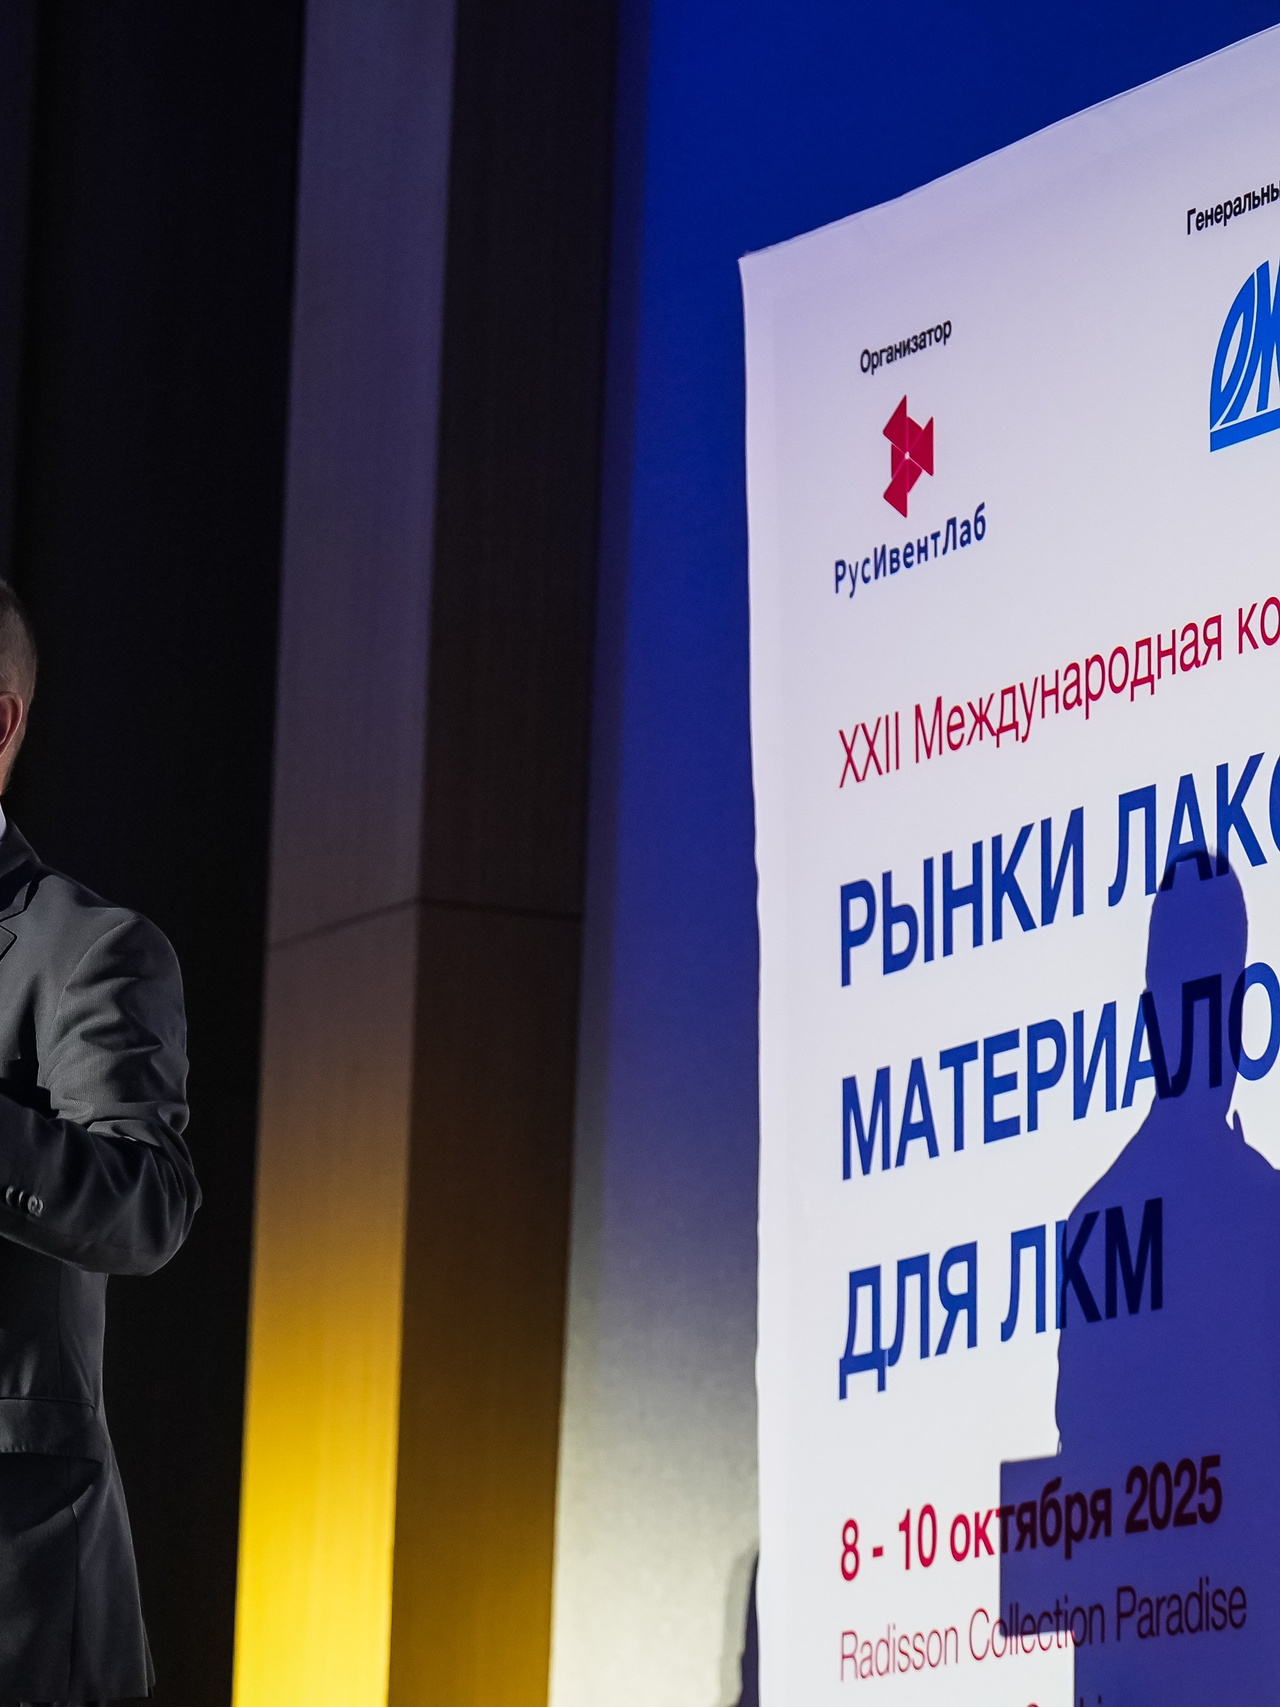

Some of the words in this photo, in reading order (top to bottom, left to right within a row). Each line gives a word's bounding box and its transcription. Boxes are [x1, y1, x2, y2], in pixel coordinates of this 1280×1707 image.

[859, 321, 952, 375] Организатор
[834, 502, 987, 598] РусИвентЛаб
[838, 711, 900, 788] XXII
[914, 614, 1222, 764] Международная
[1237, 596, 1280, 655] ко
[839, 806, 1085, 988] РЫНКИ
[1107, 751, 1280, 908] ЛАК
[841, 962, 1280, 1181] МАТЕРИАЛО
[838, 1240, 978, 1401] ДЛЯ
[1000, 1196, 1163, 1343] ЛКМ
[840, 1518, 860, 1582] 8
[872, 1545, 884, 1558] -
[898, 1503, 938, 1571] 10
[949, 1476, 1113, 1562] октября
[1124, 1454, 1223, 1535] 2025
[840, 1623, 959, 1683] Radisson
[969, 1595, 1106, 1661] Collection
[1116, 1576, 1248, 1643] Paradise
